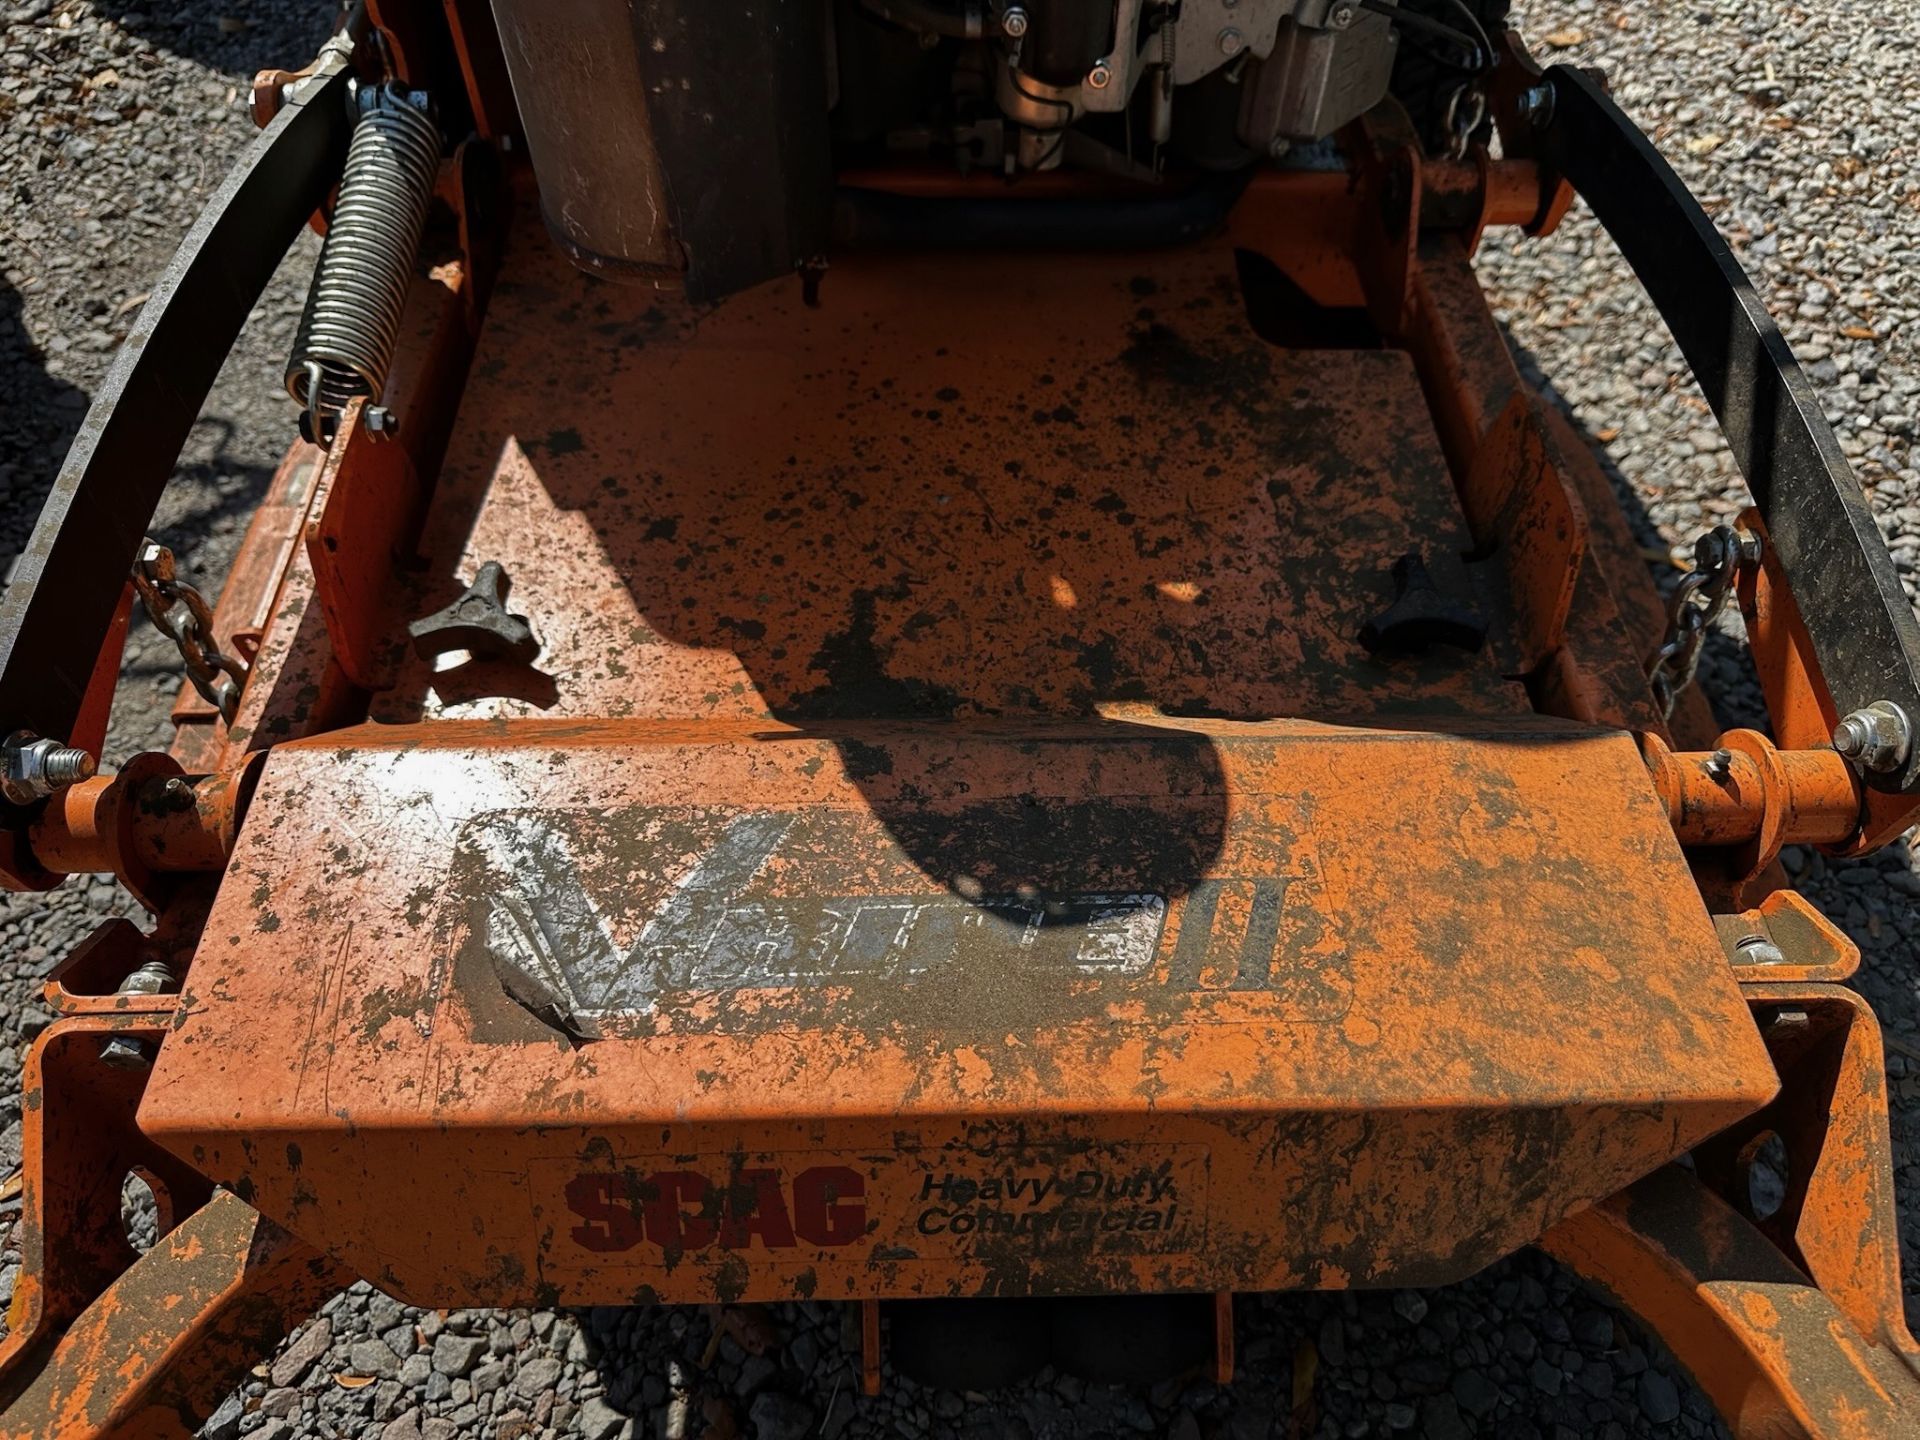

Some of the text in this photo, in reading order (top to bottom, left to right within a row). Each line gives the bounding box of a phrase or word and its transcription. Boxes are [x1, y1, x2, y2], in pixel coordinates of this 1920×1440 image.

[920, 1170, 1178, 1206] Heavy Duty
[565, 1166, 866, 1252] SCAG
[917, 1204, 1178, 1235] Commercial
